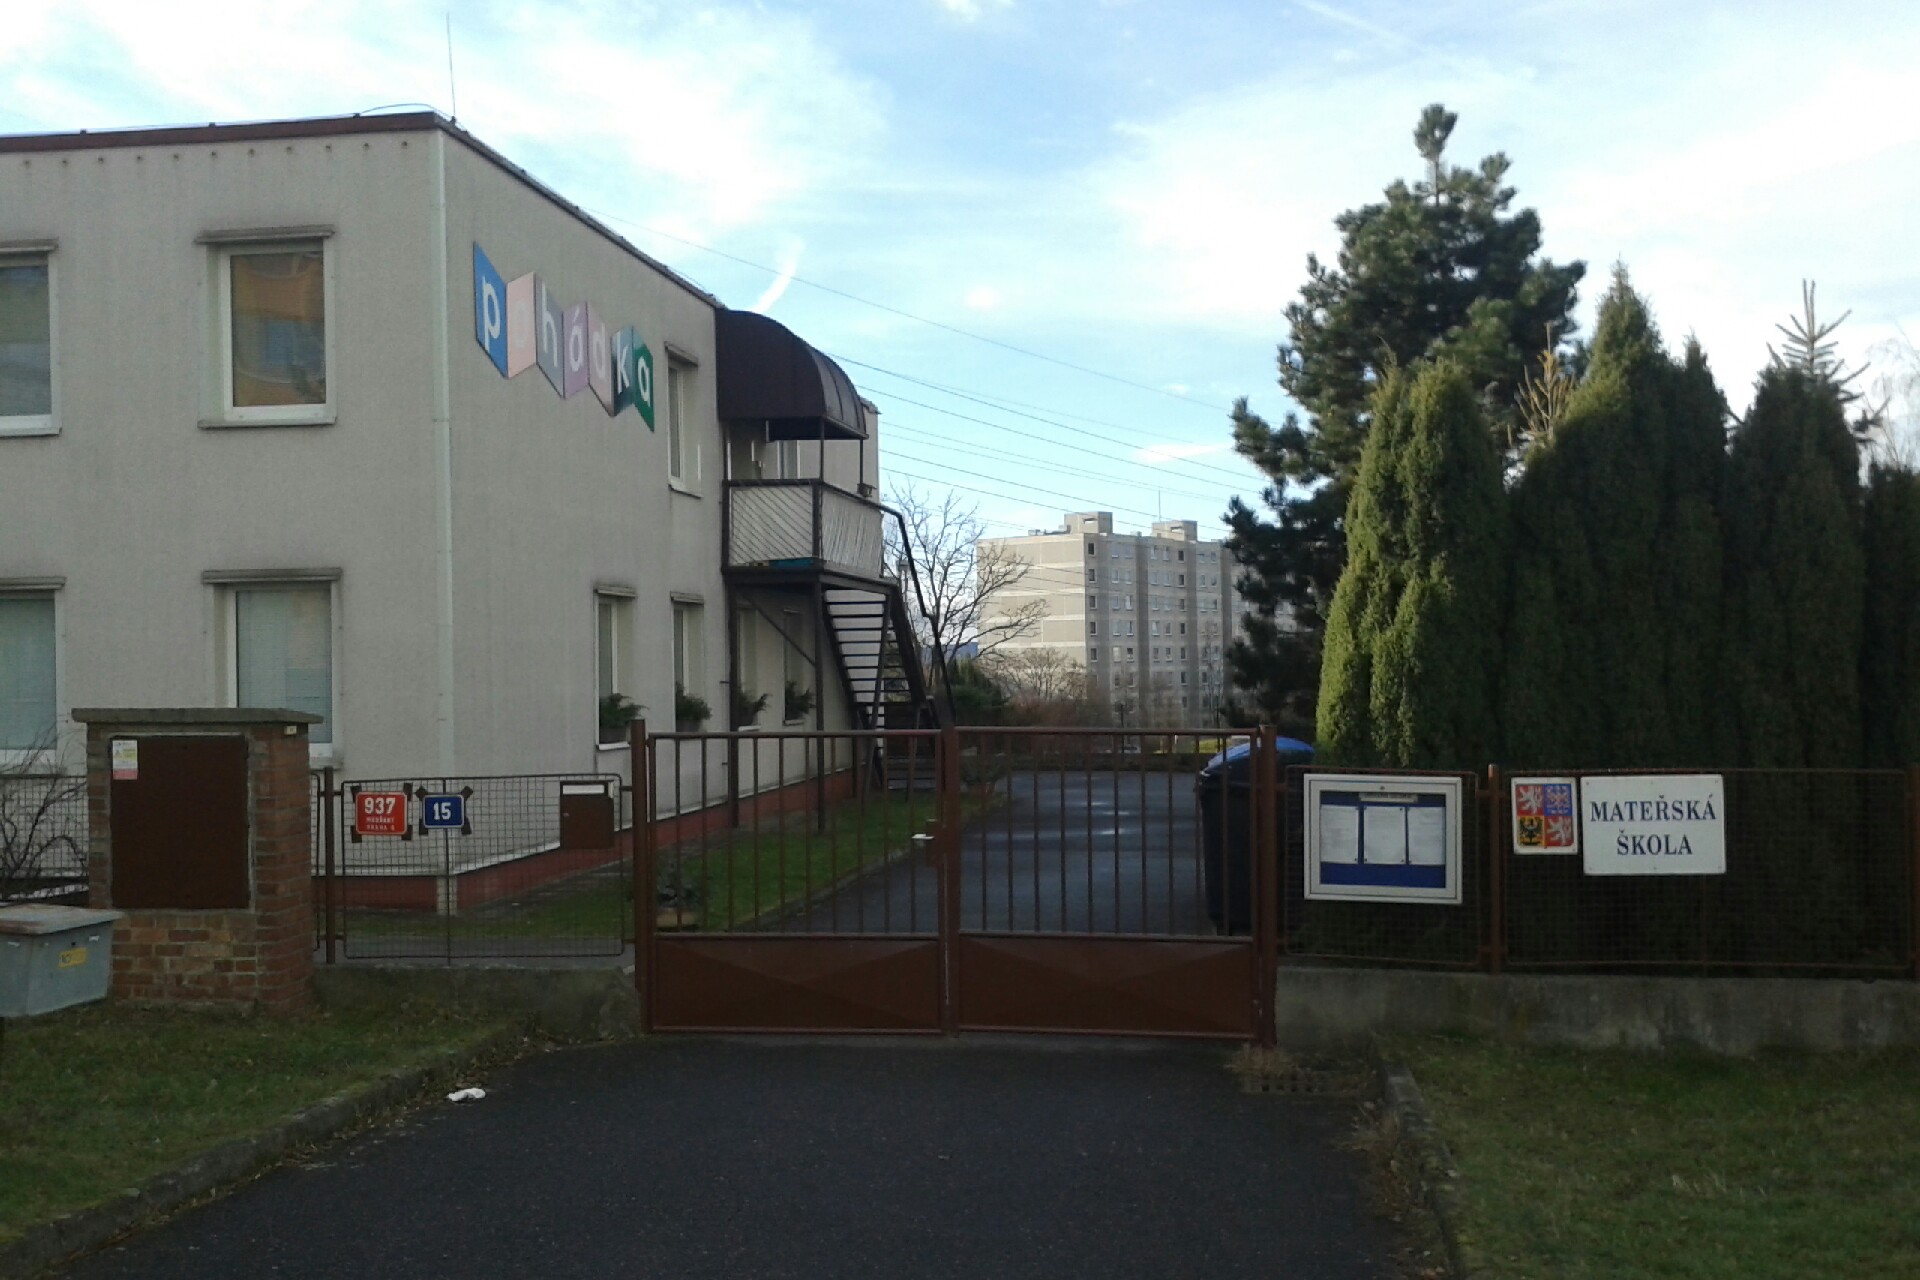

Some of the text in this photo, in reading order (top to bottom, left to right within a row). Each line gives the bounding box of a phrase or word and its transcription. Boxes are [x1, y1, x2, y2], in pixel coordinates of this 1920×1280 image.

[482, 274, 652, 408] pohádka
[365, 797, 396, 814] 937
[433, 802, 452, 820] 15
[1590, 793, 1717, 822] MATEŘSKÁ
[1617, 828, 1692, 856] ŠKOLA
